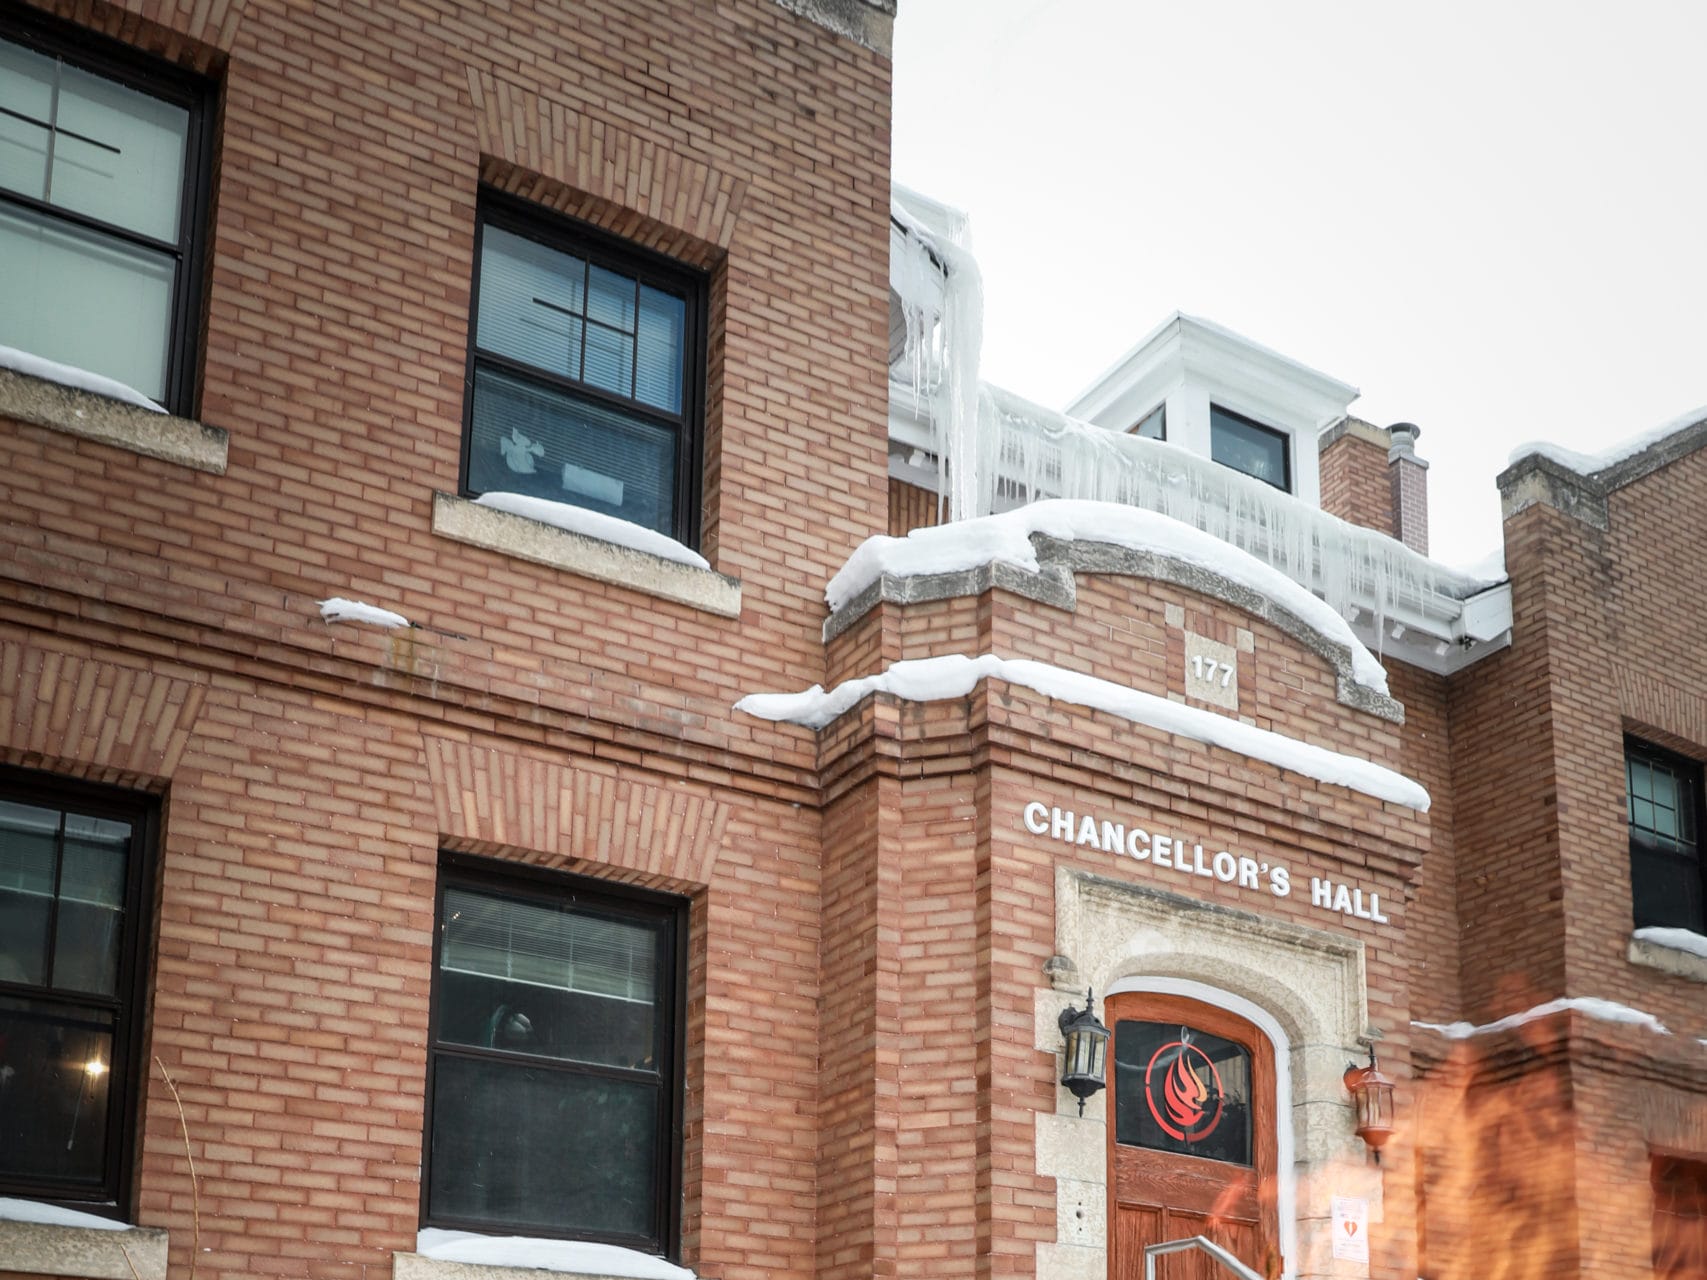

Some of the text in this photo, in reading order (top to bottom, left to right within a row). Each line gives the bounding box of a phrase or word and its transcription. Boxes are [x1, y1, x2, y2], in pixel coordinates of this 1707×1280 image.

[1191, 655, 1234, 689] 177
[1023, 801, 1388, 923] CHANCELLOR'S HALL
